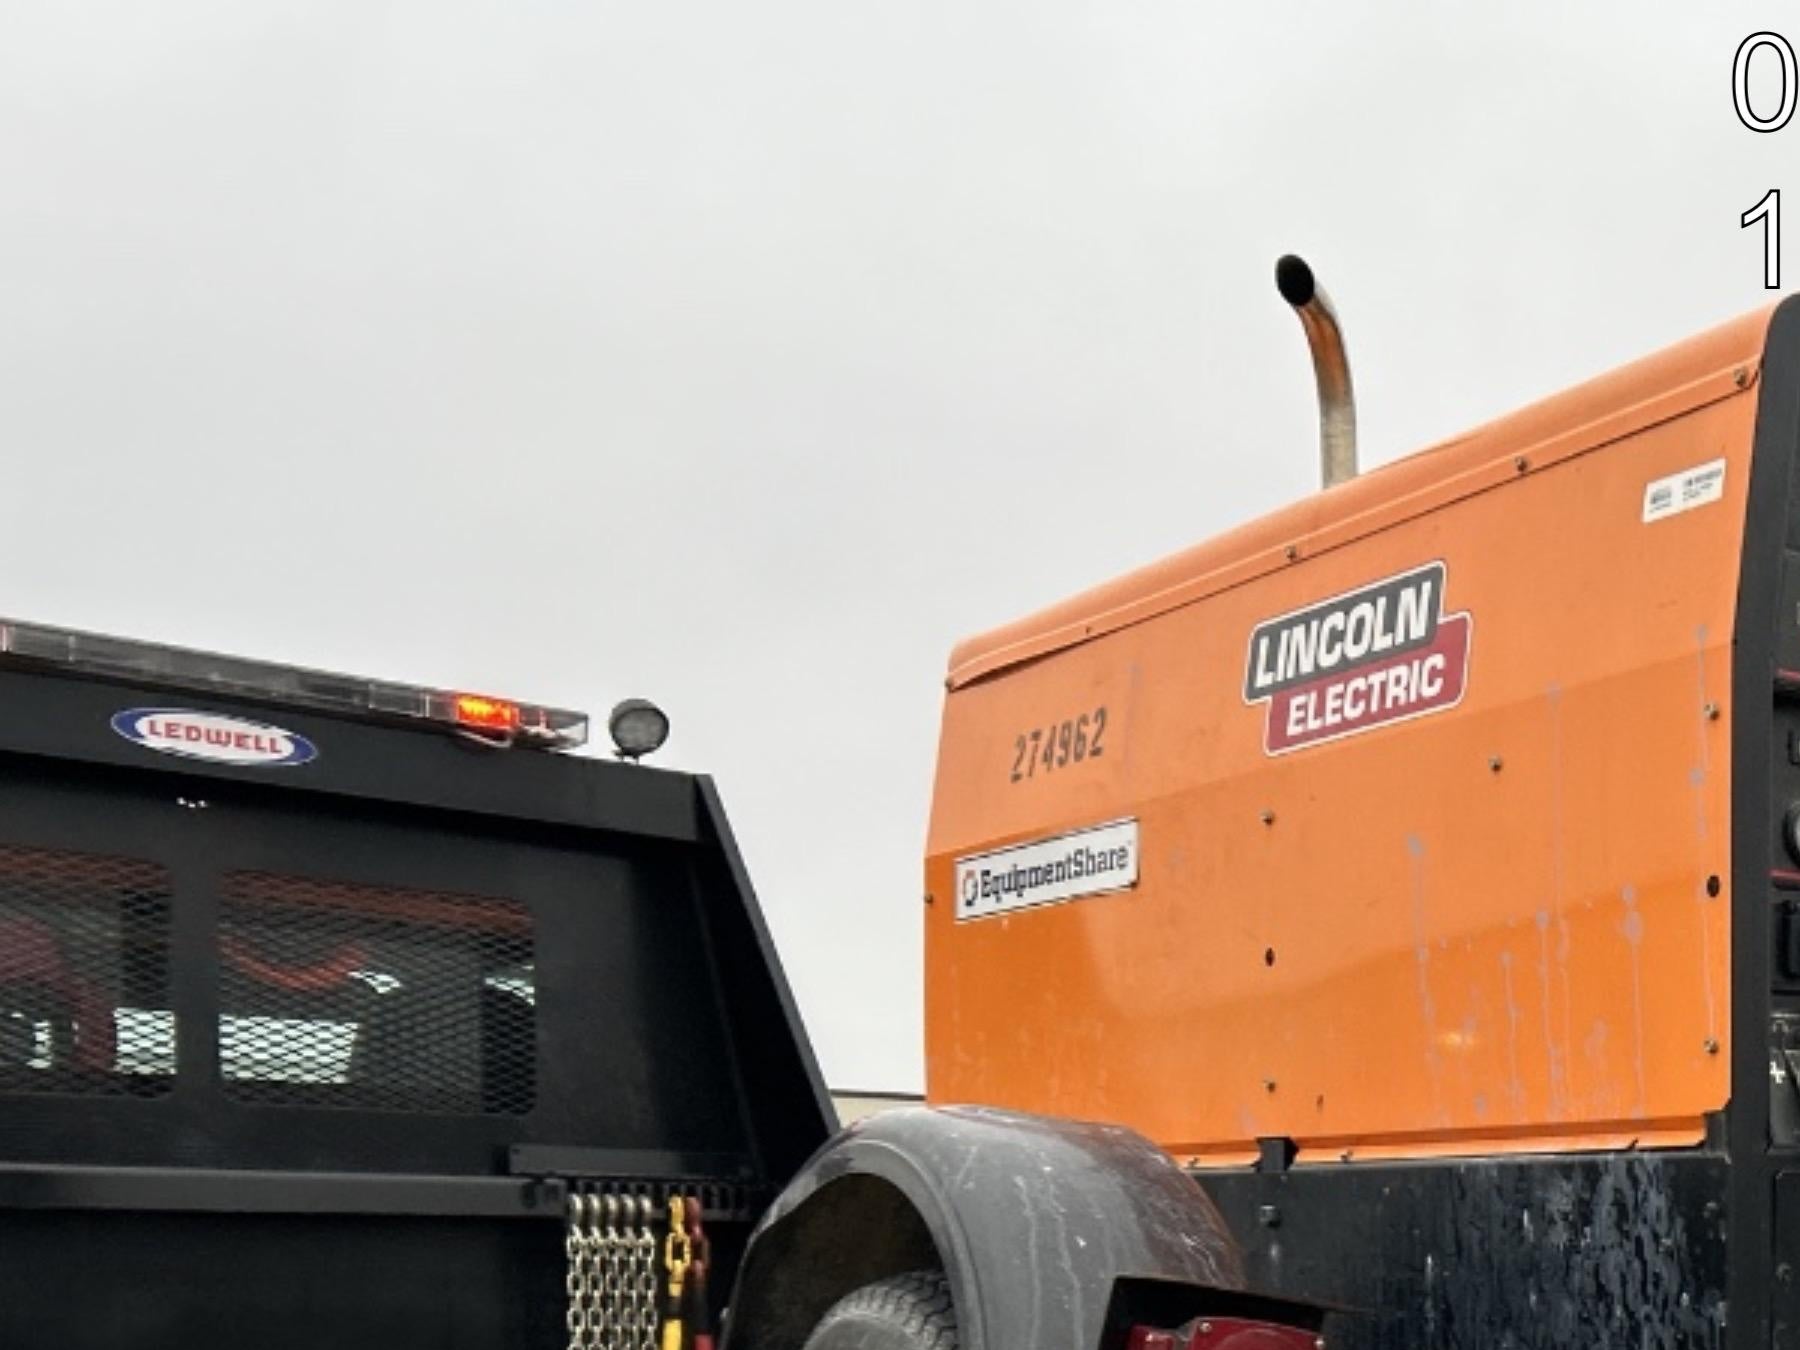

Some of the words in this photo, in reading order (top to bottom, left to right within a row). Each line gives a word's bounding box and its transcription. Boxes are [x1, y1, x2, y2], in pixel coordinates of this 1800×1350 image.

[1256, 580, 1432, 688] LINCOLN
[1286, 653, 1446, 737] ELECTRIC
[147, 718, 284, 754] LEDWELL
[1010, 707, 1108, 784] 274962
[980, 844, 1129, 904] EquipmentShare
